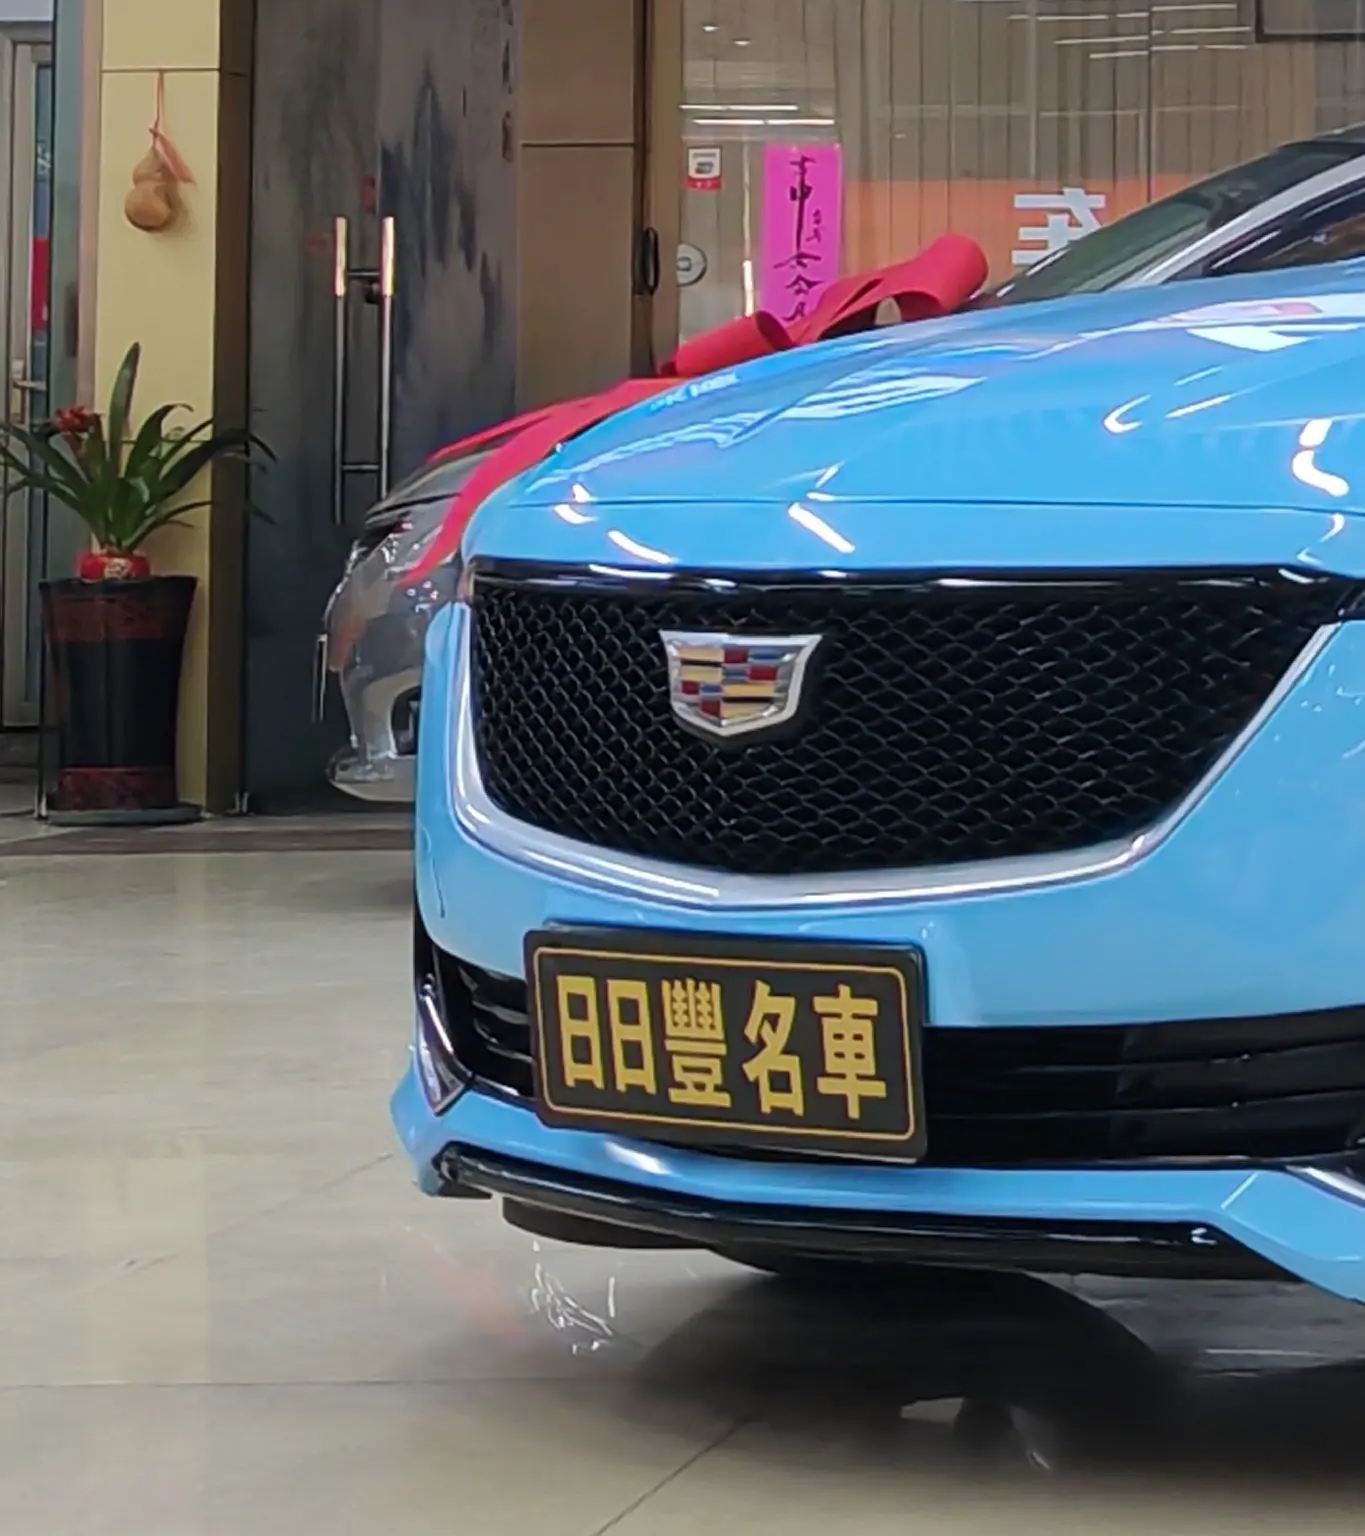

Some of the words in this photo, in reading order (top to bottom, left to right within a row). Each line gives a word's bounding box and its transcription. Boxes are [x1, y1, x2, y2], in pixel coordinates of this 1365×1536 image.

[554, 974, 888, 1121] 日日豐名車
